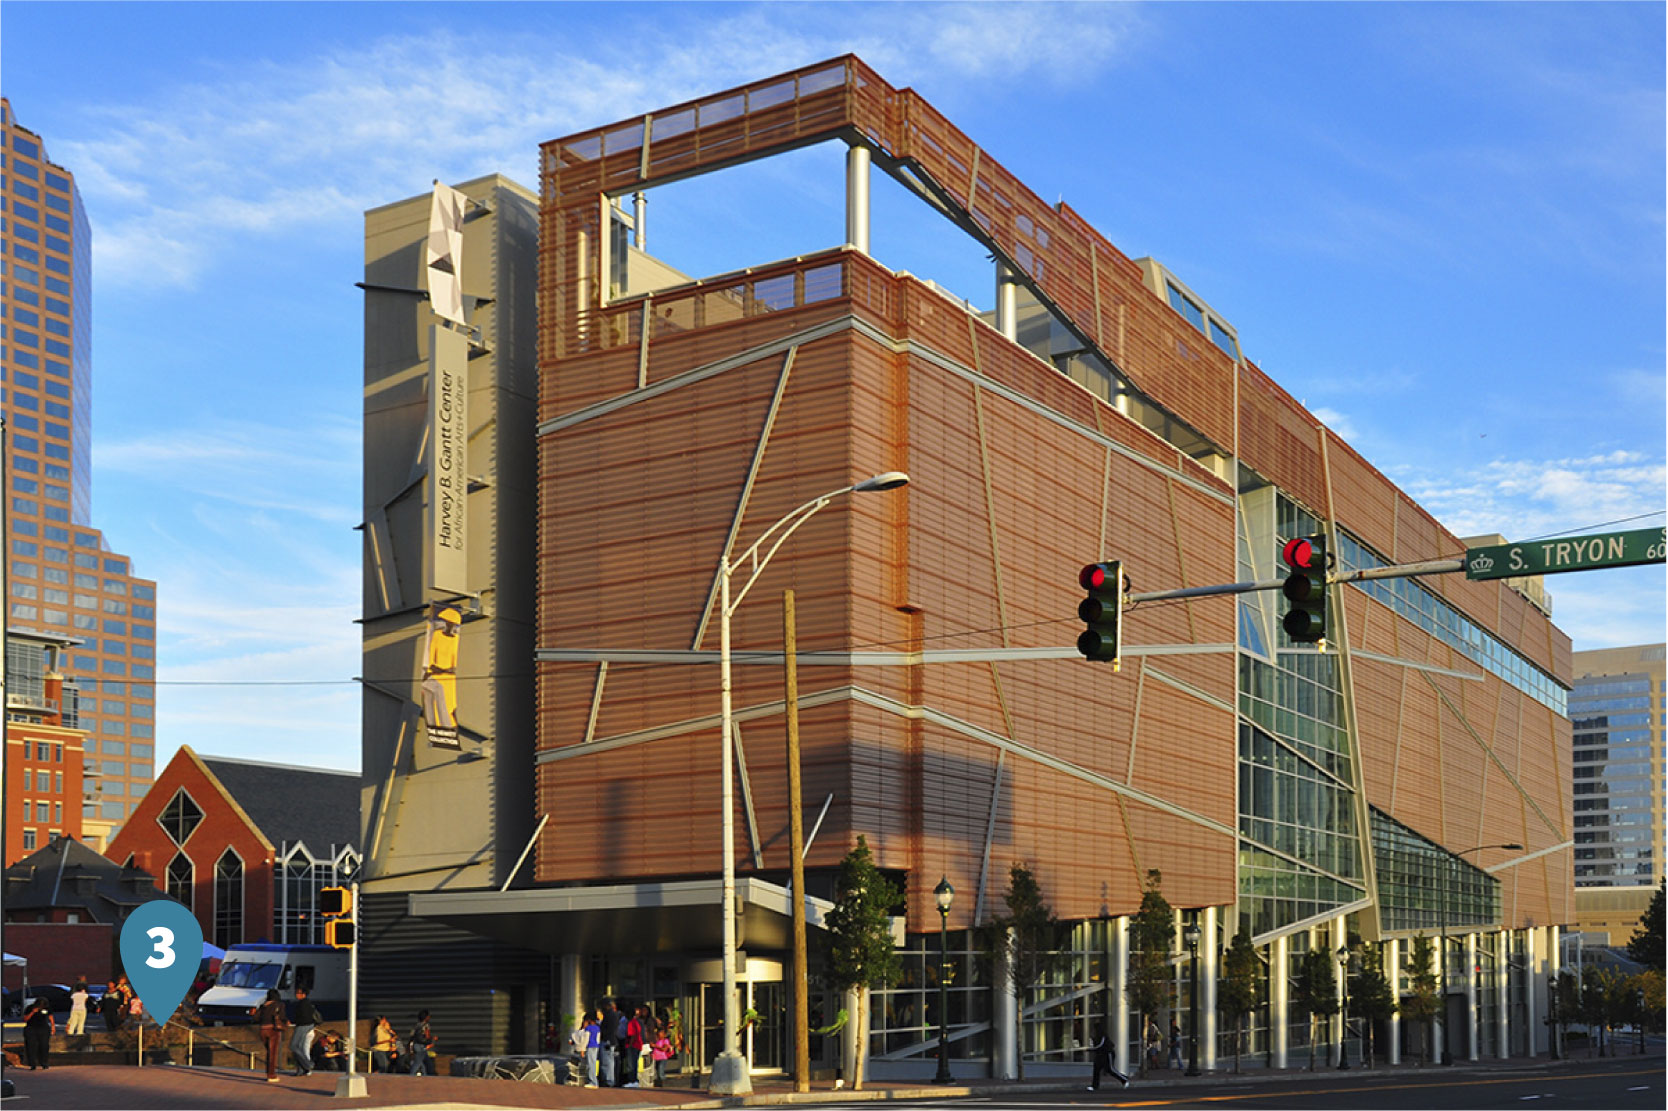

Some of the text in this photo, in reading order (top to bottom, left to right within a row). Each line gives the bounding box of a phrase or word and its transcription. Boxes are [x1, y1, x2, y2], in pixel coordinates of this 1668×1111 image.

[439, 370, 454, 548] Harvey B. Gantt Center
[454, 446, 464, 534] African-American
[454, 536, 464, 551] for
[1509, 536, 1624, 570] S. TRYON
